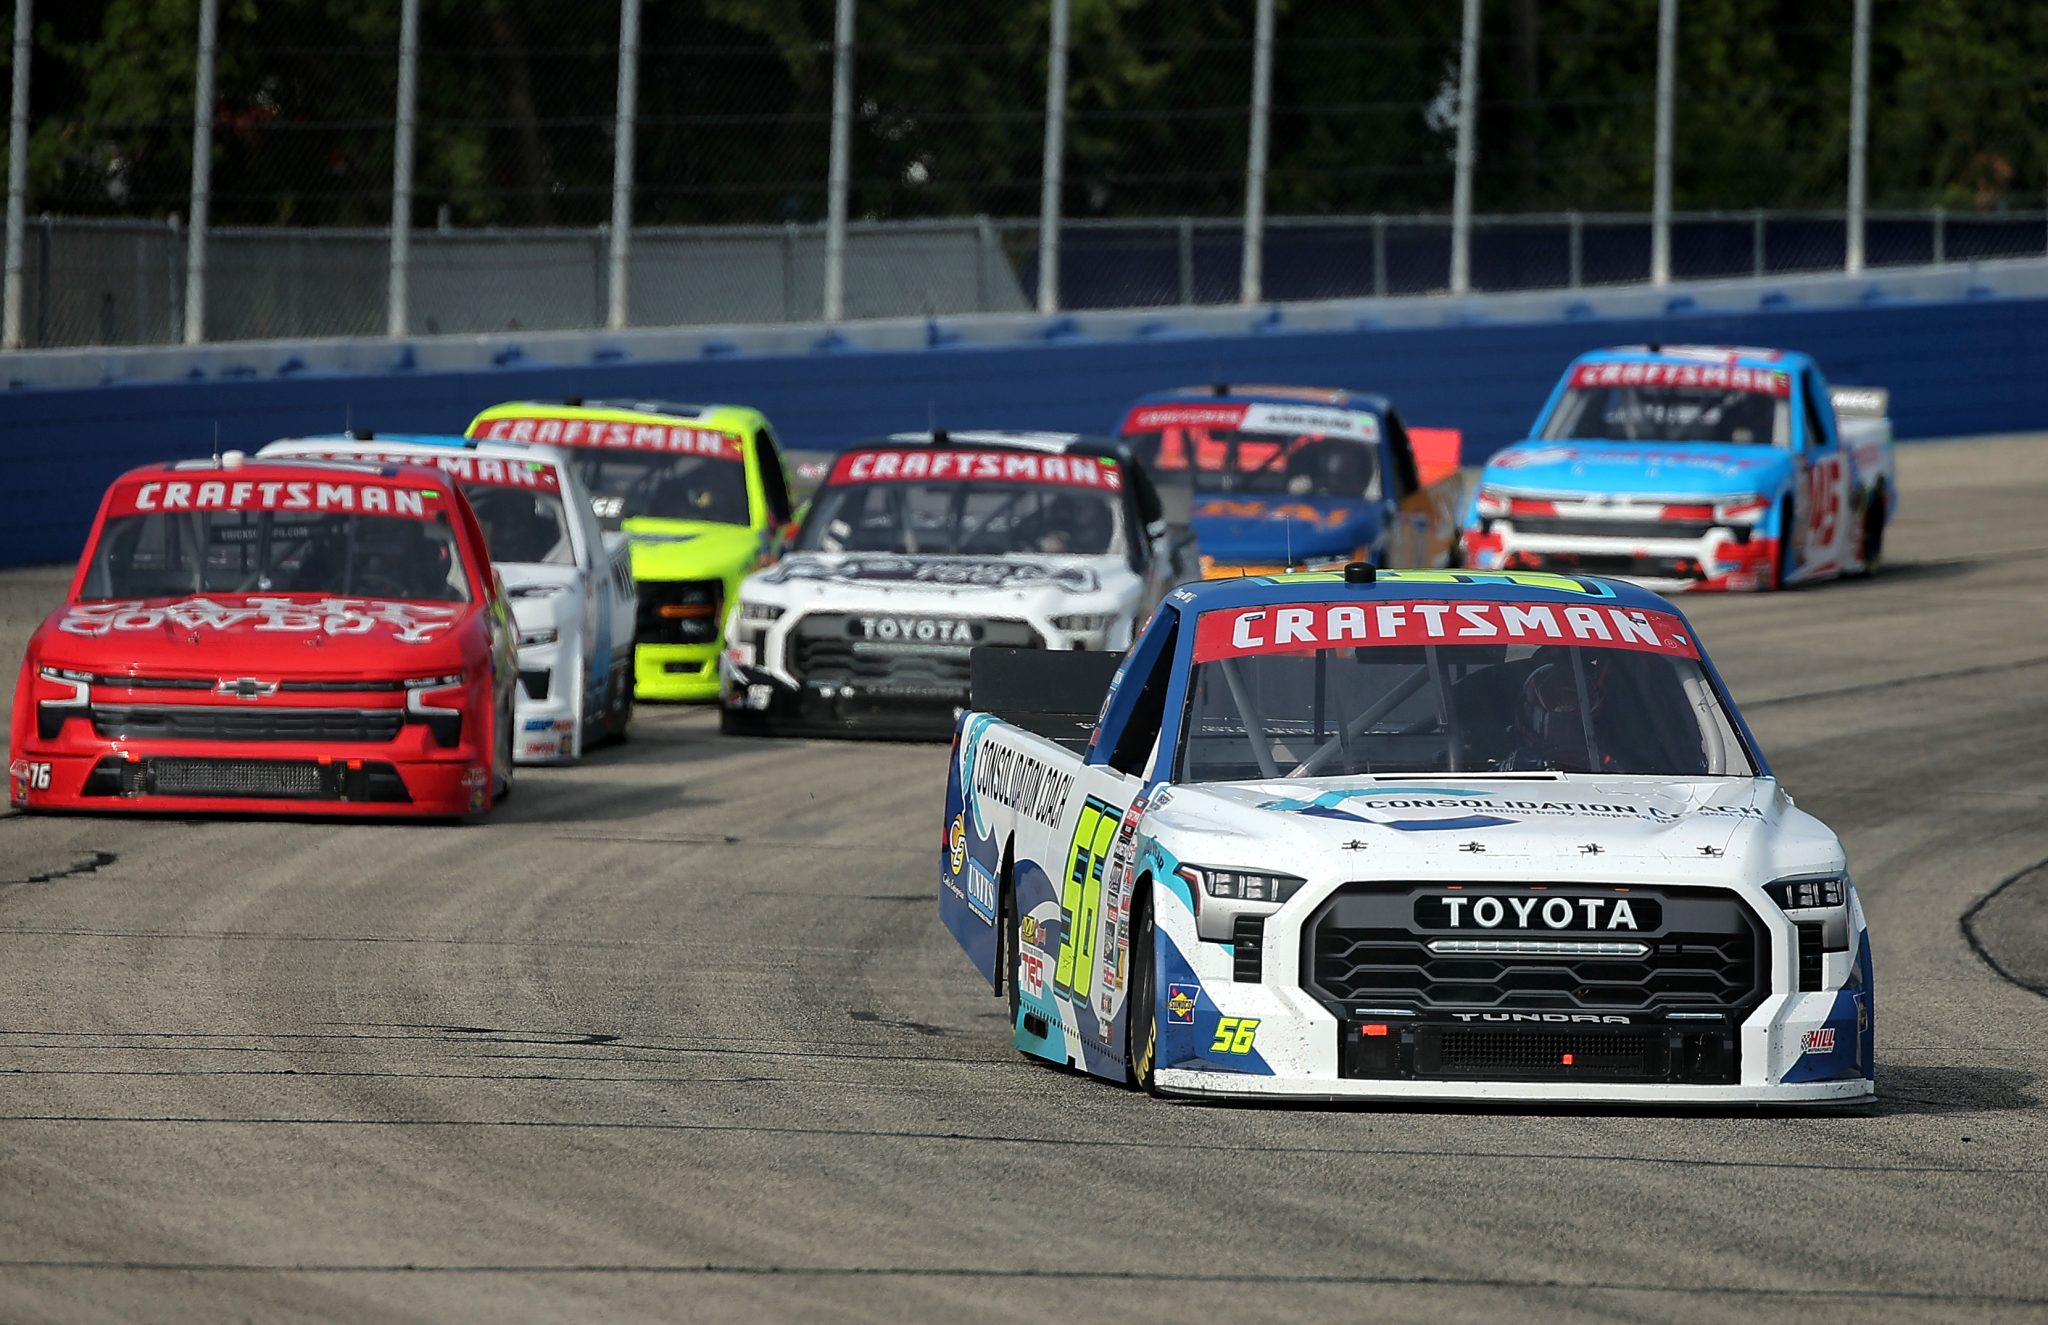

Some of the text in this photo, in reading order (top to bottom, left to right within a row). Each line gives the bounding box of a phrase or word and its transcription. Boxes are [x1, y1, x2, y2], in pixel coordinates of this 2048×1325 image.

[486, 419, 723, 452] CRAFTSMAN
[850, 452, 1099, 485] CRAFTSMAN
[135, 481, 425, 516] CRAFTSMAN
[860, 617, 973, 643] TOYOTA
[1231, 604, 1662, 648] CRAFTSMAN
[30, 762, 52, 789] 76
[977, 739, 1047, 819] CONSOLIDATION
[1035, 766, 1076, 831] COACH
[1366, 799, 1637, 814] CONSOLIDATION
[967, 863, 995, 912] UNITS
[1054, 795, 1123, 1006] 56
[1441, 897, 1639, 930] TOYOTA
[1209, 1016, 1261, 1054] 56
[1452, 1013, 1631, 1025] TUNDRA
[1807, 1028, 1835, 1048] HILL
